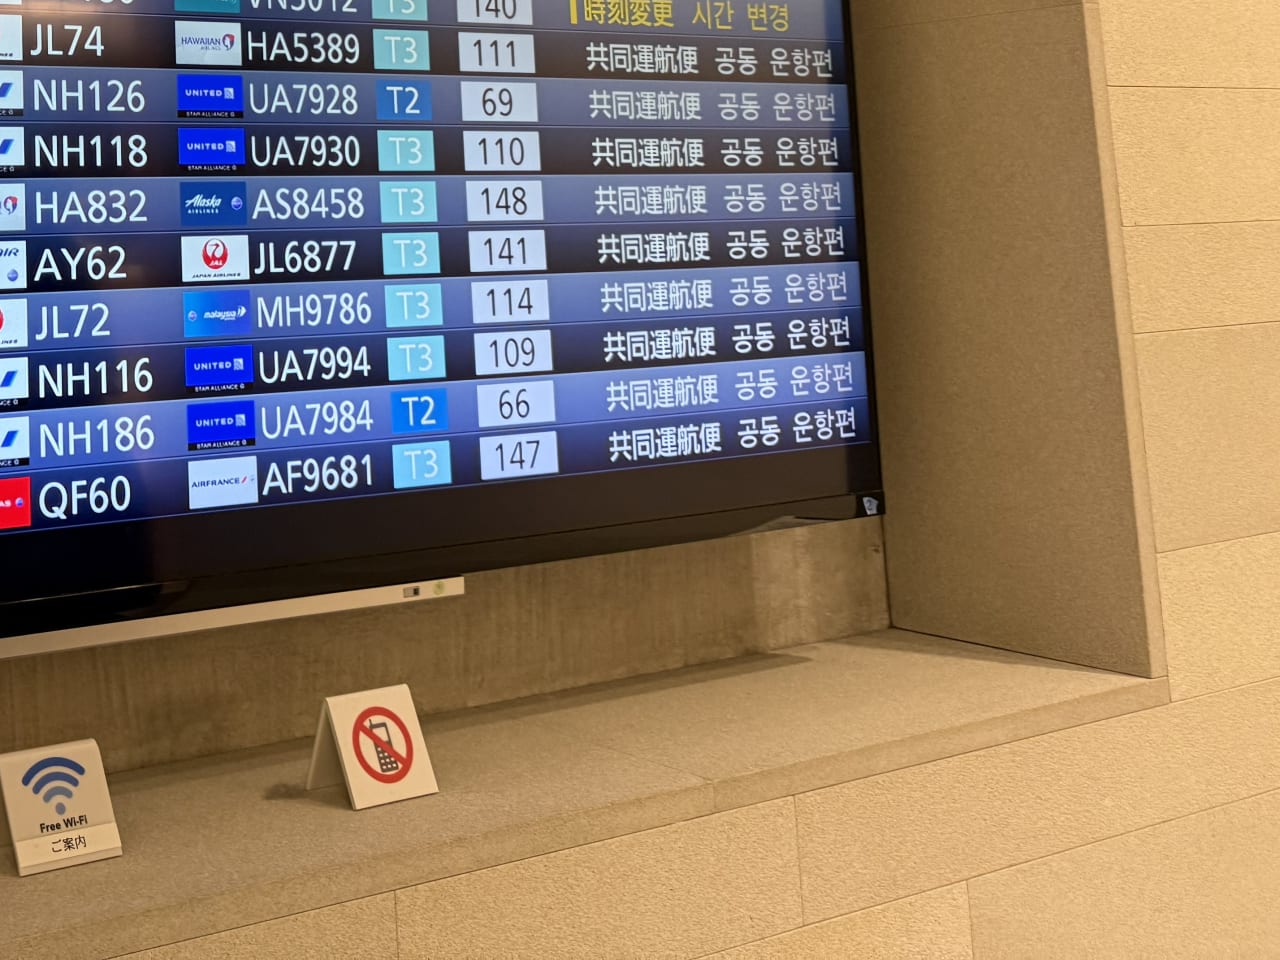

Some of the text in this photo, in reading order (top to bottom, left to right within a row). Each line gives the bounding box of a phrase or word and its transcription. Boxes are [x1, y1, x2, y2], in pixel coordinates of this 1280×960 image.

[691, 0, 789, 33] 시간 변경
[29, 22, 105, 57] JL74
[247, 30, 360, 64] HA5389
[33, 79, 146, 113] NH126
[186, 89, 222, 97] UNITED
[249, 83, 358, 115] UA7928
[385, 86, 421, 114] T2
[34, 134, 148, 168] NH118
[250, 135, 361, 167] UA7930
[477, 136, 525, 166] 110
[35, 188, 148, 224] HA832
[252, 187, 365, 221] AS8458
[34, 245, 128, 282] AY62
[253, 239, 356, 274] JL6877
[256, 292, 372, 328] MH9786
[486, 286, 533, 316] 114
[35, 302, 111, 341] JL72
[731, 315, 850, 354] 공동 운항편
[602, 326, 717, 363] 共同運航便
[38, 357, 153, 399] NH116
[258, 345, 371, 384] UA7994
[261, 399, 374, 440] UA7984
[401, 395, 437, 426] T2
[39, 413, 155, 458] NH186
[494, 439, 541, 471] 147
[262, 453, 372, 496] AF9681
[38, 475, 131, 520] QF60
[40, 815, 88, 833] Free Wi-Fi
[51, 835, 87, 853] ご案内
